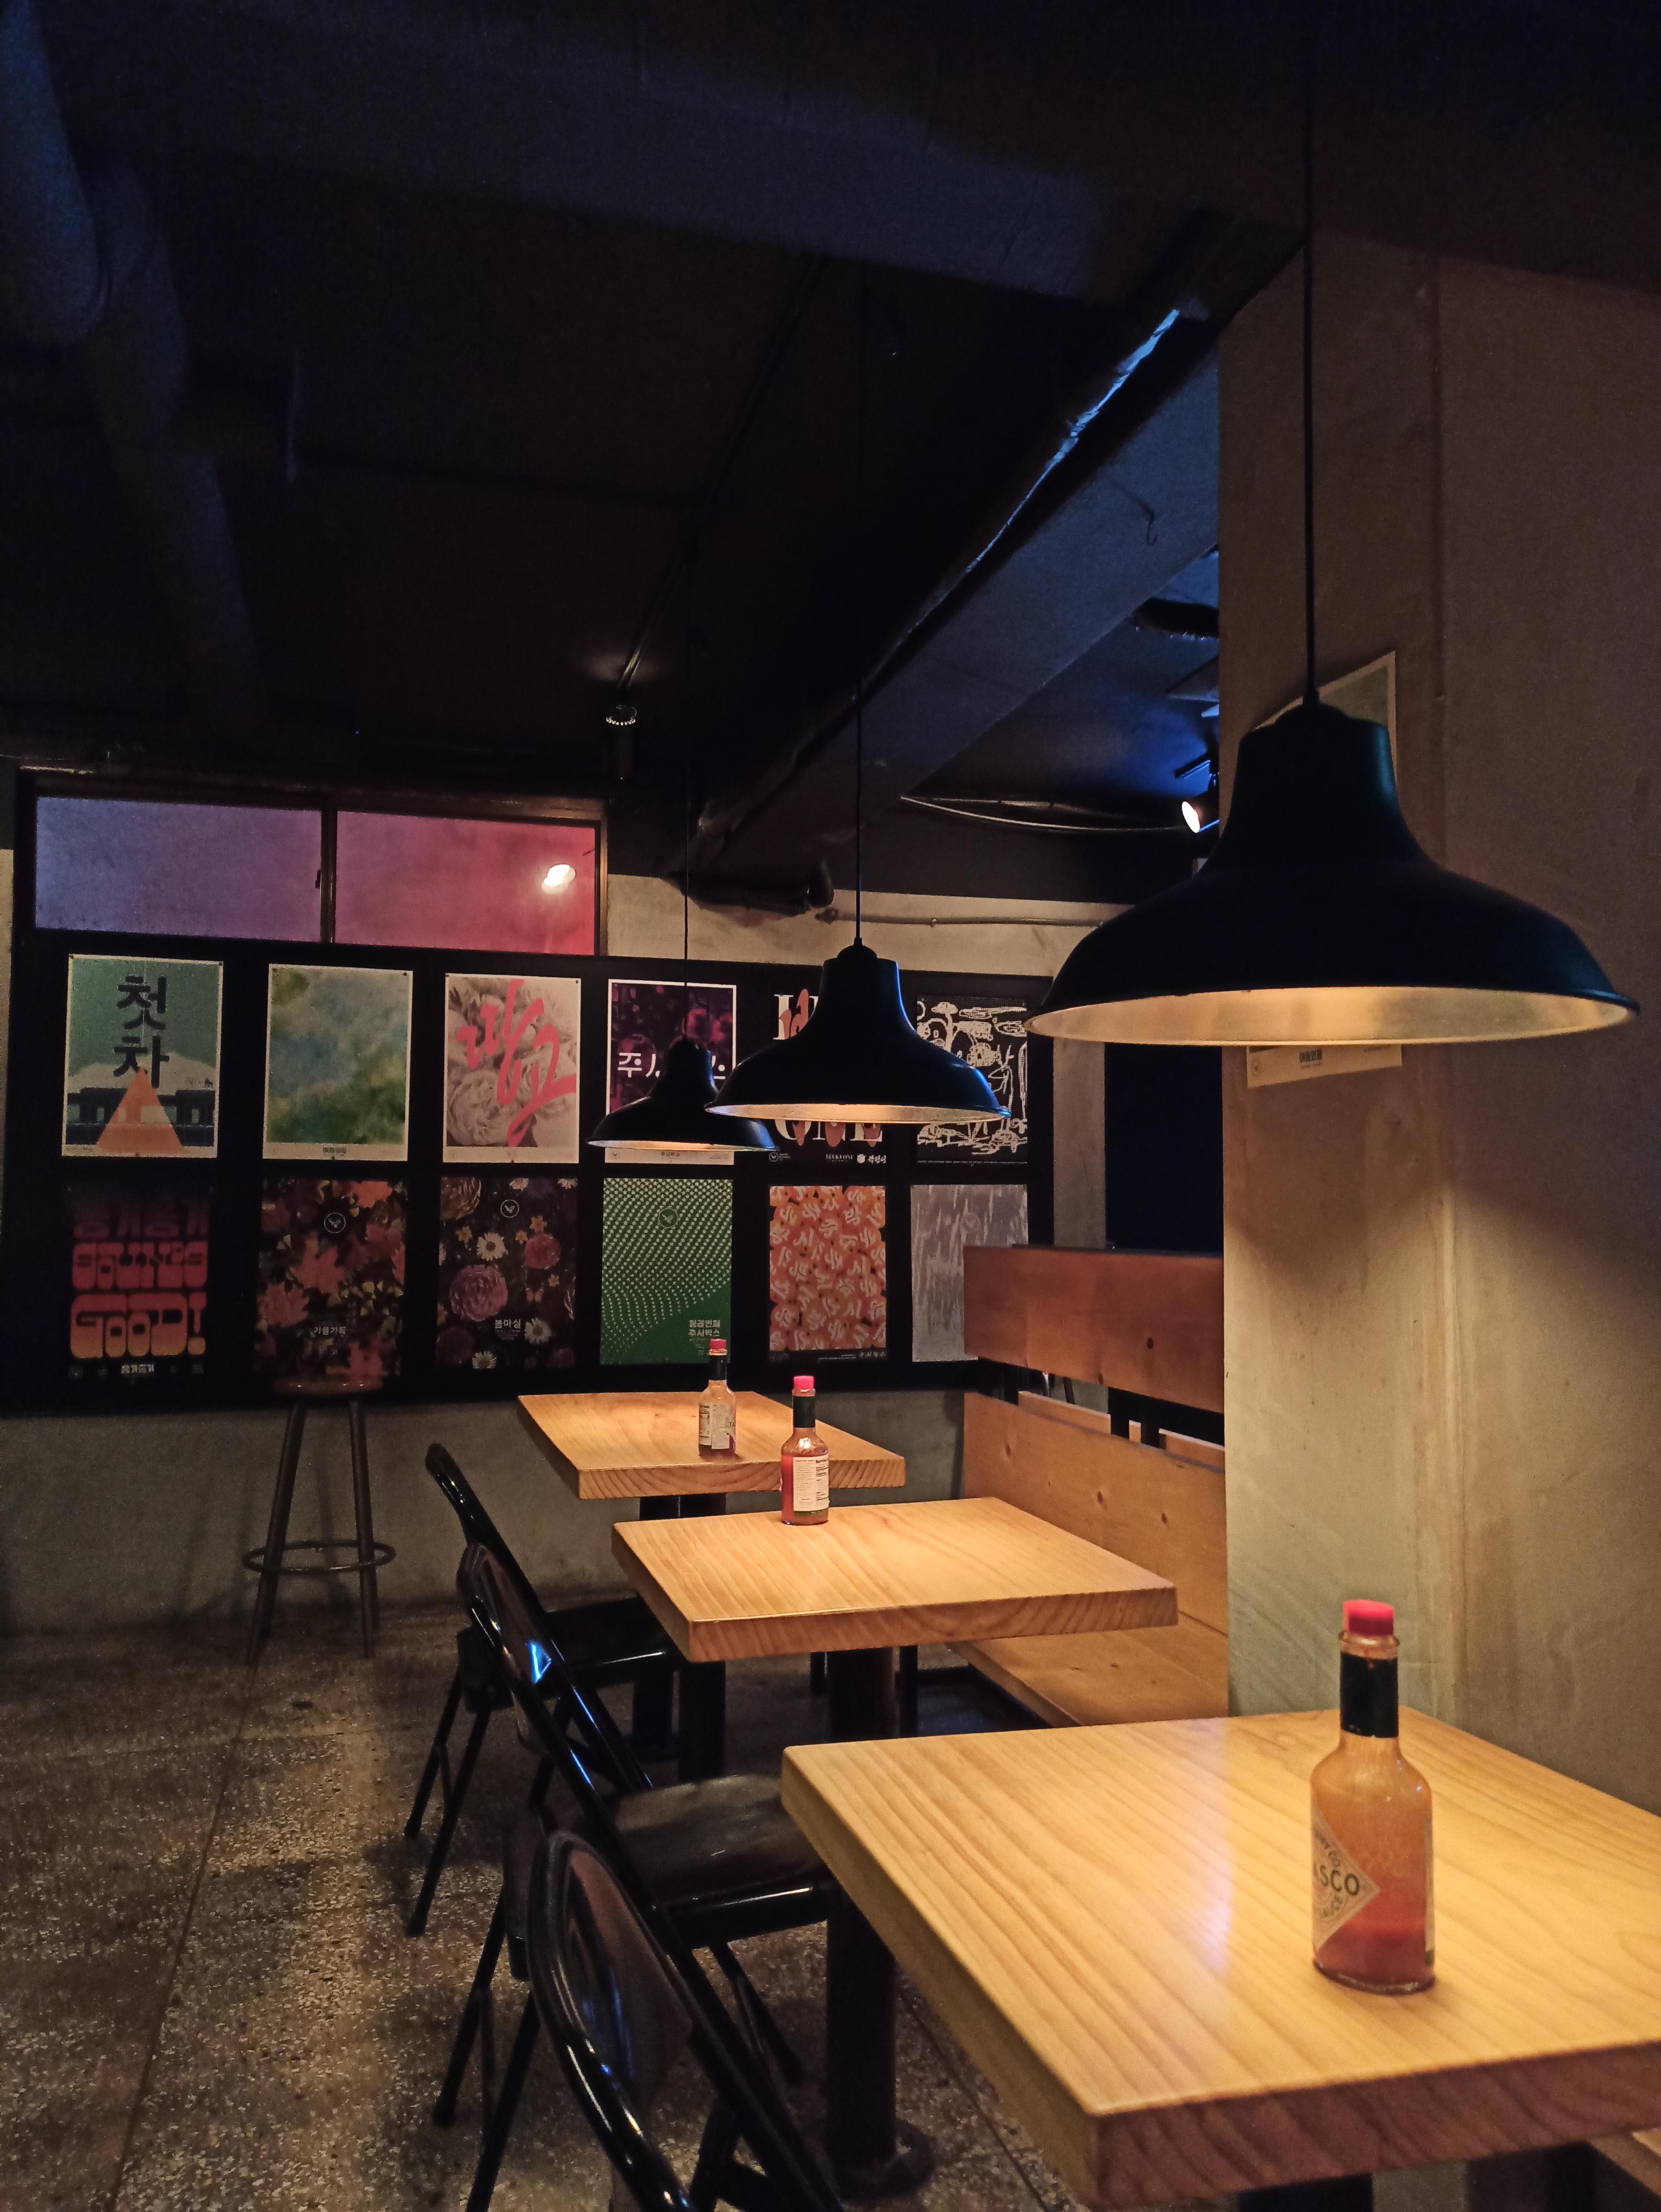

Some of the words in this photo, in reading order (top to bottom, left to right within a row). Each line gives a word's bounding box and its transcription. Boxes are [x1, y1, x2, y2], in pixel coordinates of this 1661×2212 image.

[113, 976, 169, 1088] 첫차
[494, 1318, 521, 1329] 봄마실
[314, 1327, 346, 1337] 가을가득
